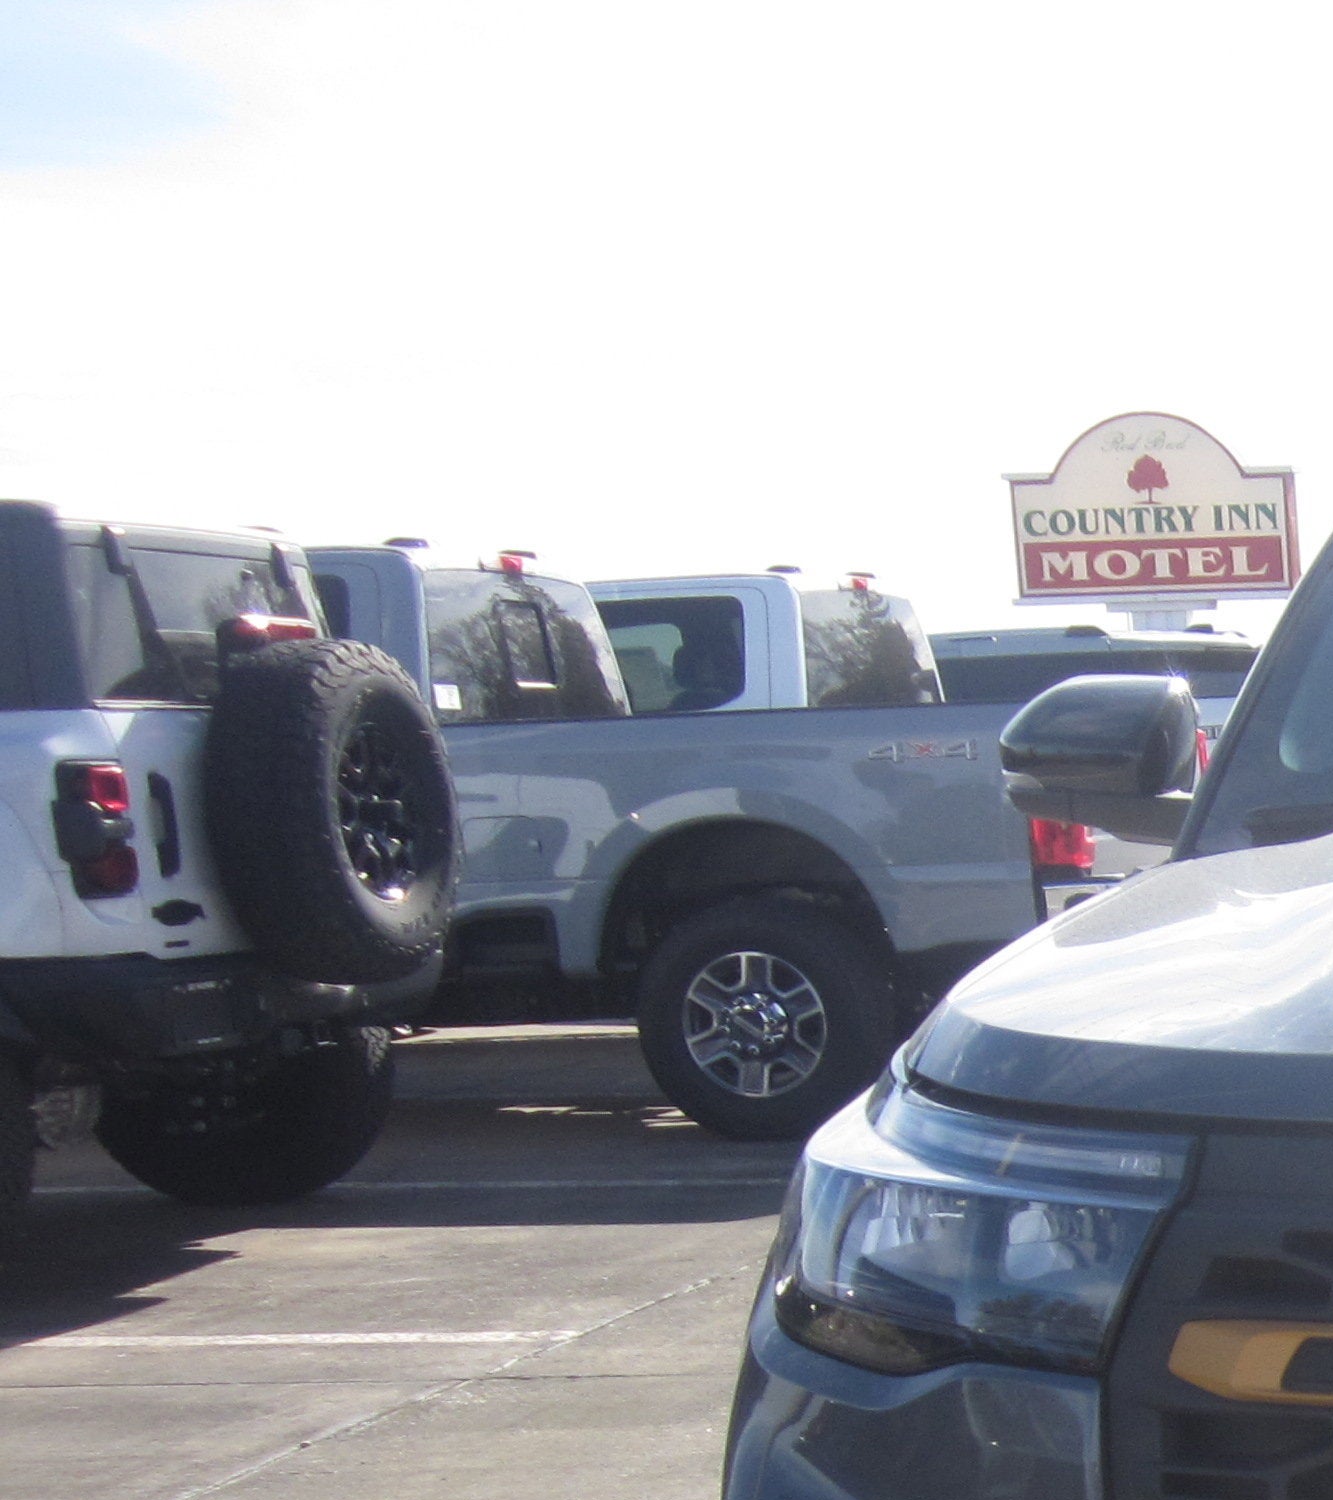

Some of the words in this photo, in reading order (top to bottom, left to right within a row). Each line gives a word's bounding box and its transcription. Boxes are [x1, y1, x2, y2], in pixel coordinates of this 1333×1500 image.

[1023, 504, 1200, 537] COUNTRY
[1212, 502, 1279, 531] INN
[1039, 546, 1269, 582] MOTEL
